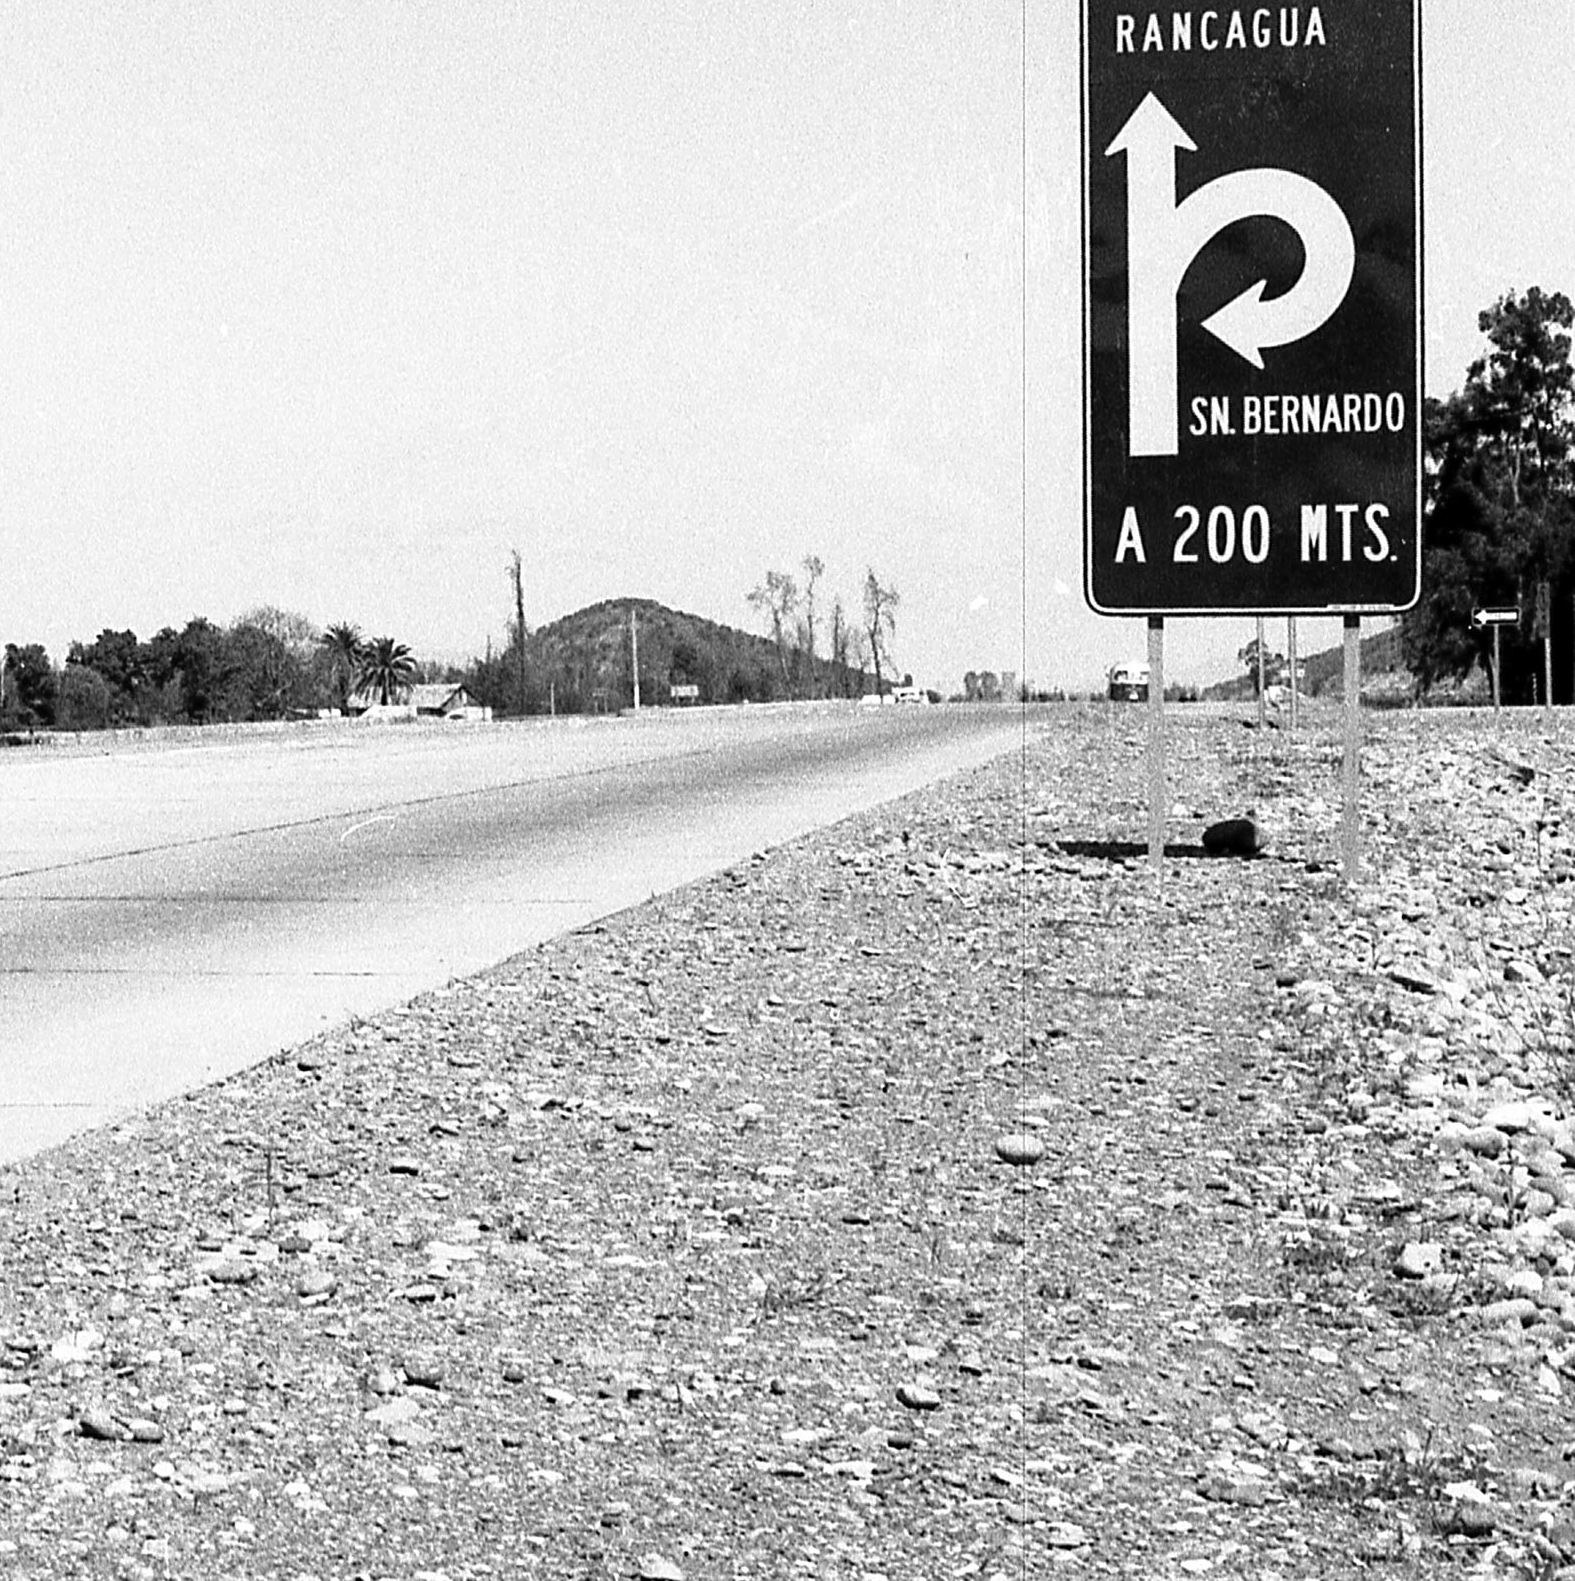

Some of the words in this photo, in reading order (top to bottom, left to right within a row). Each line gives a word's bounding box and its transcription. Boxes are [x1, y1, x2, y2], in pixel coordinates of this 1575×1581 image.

[1116, 6, 1326, 53] RANCAGUA
[1189, 396, 1236, 436] SN.
[1243, 392, 1405, 435] BERNARDO
[1114, 506, 1146, 563] A
[1173, 504, 1270, 564] 200
[1300, 503, 1398, 562] MTS.
